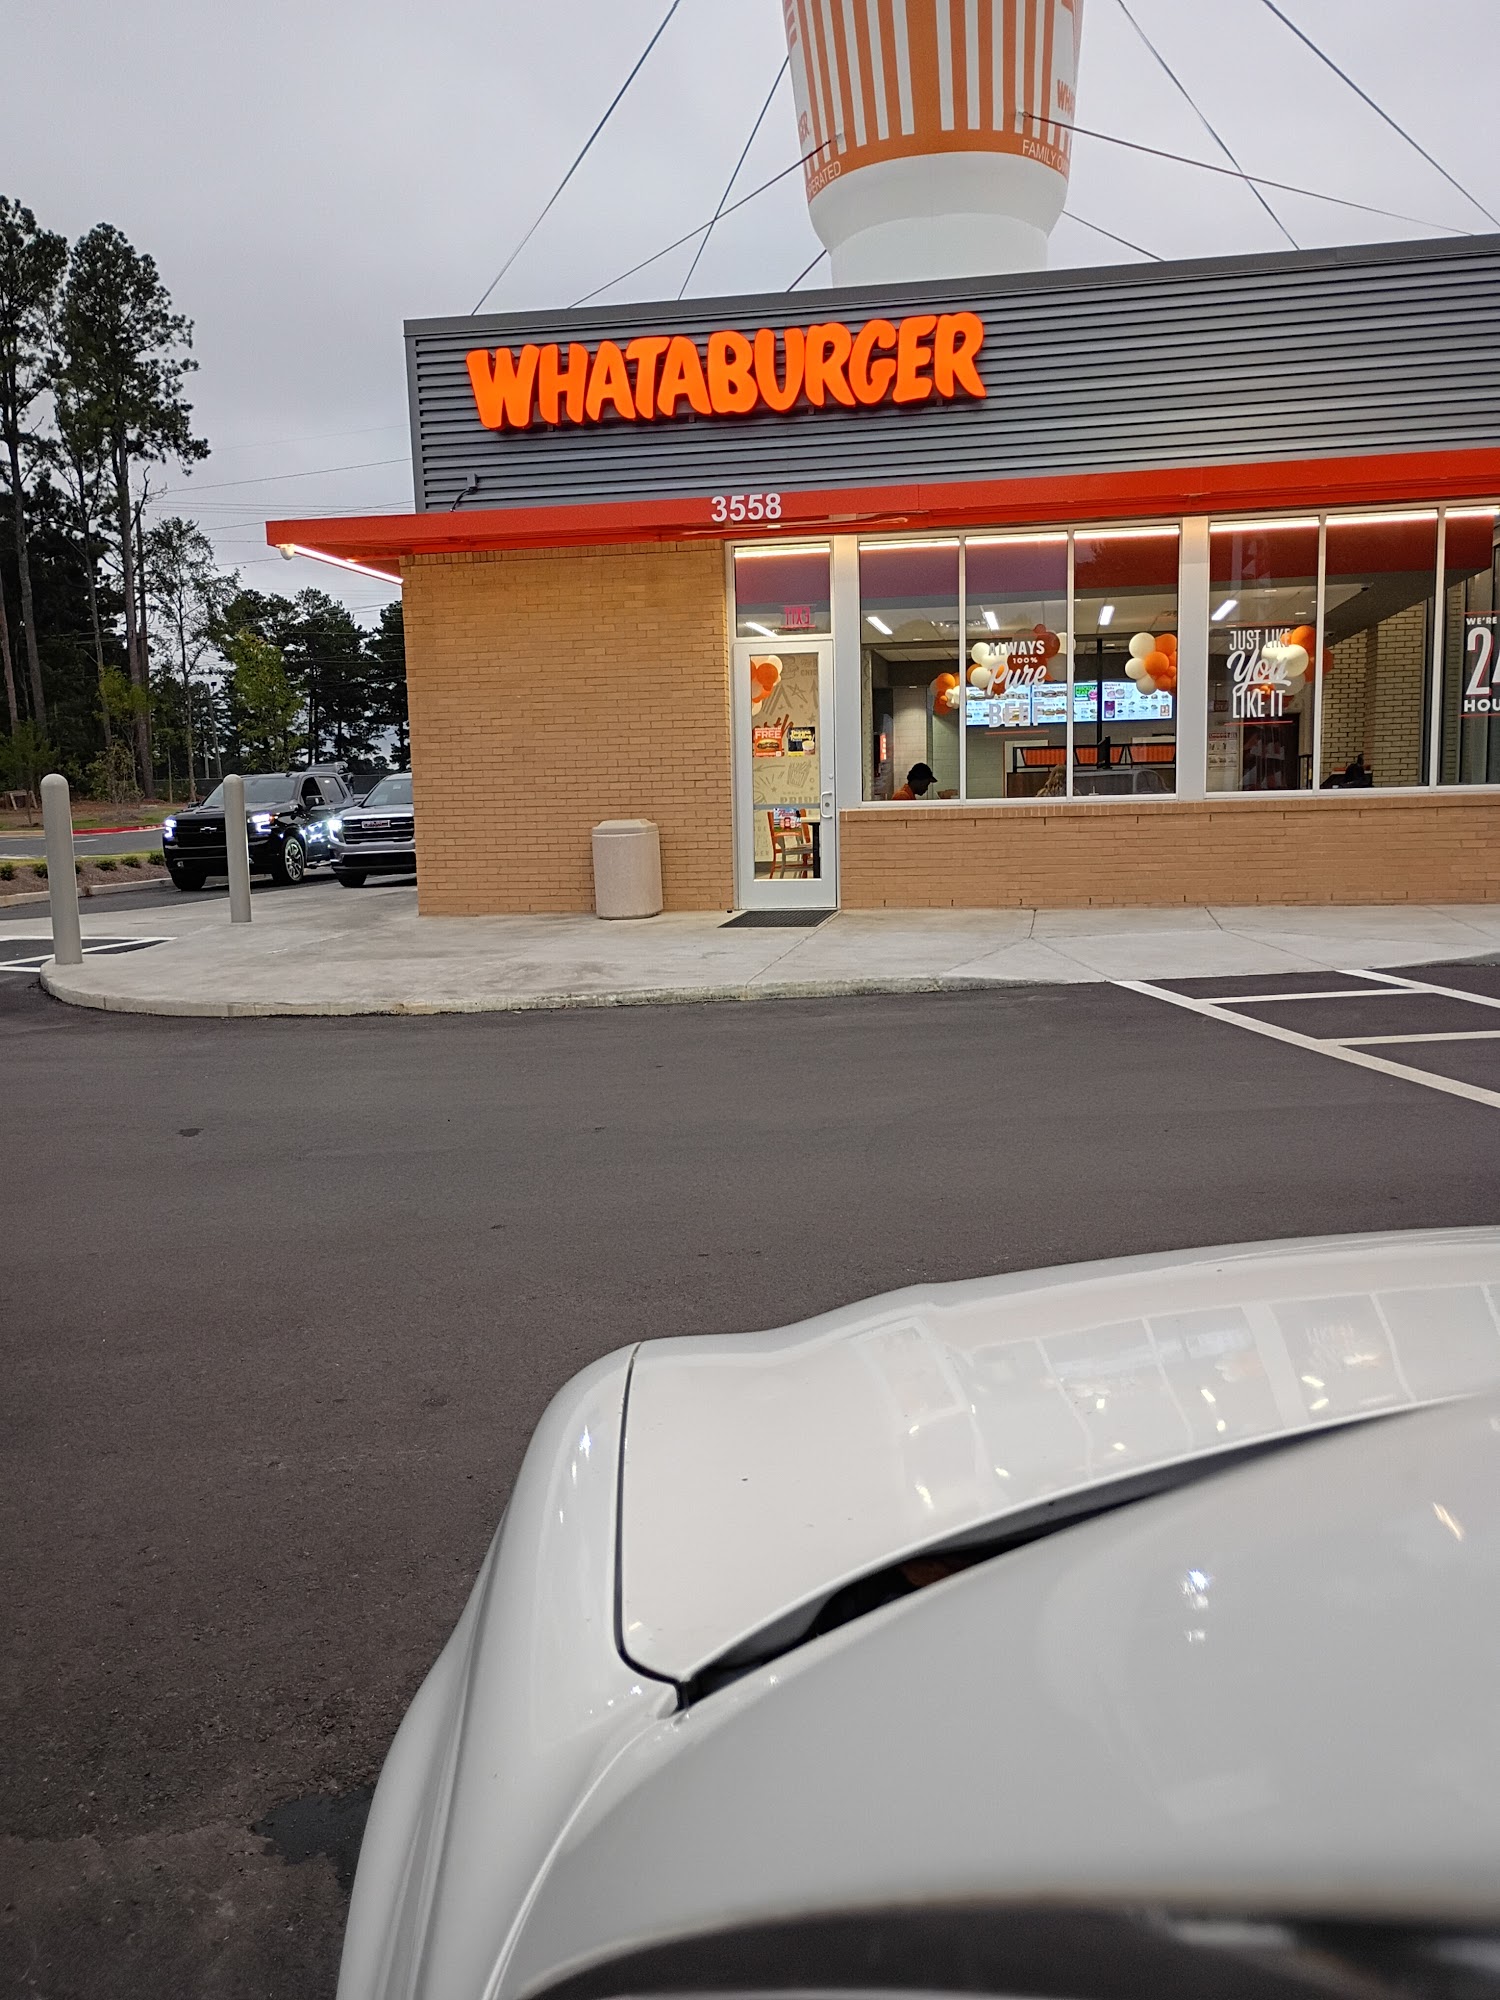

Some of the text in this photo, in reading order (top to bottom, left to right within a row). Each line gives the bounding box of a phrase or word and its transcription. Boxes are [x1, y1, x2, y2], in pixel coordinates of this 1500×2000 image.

[1022, 139, 1057, 166] FAMILY
[466, 312, 986, 431] WHATABURGER
[710, 492, 782, 523] 3558
[1466, 616, 1498, 625] WE'RE
[988, 640, 1045, 656] ALWAYS
[1229, 628, 1291, 650] JUST LIKE
[1012, 656, 1038, 664] 100%
[1226, 648, 1292, 696] You
[986, 661, 1047, 696] Pure
[988, 702, 1044, 728] BEEF
[1232, 690, 1286, 718] LIKE IT
[755, 730, 781, 739] FREE
